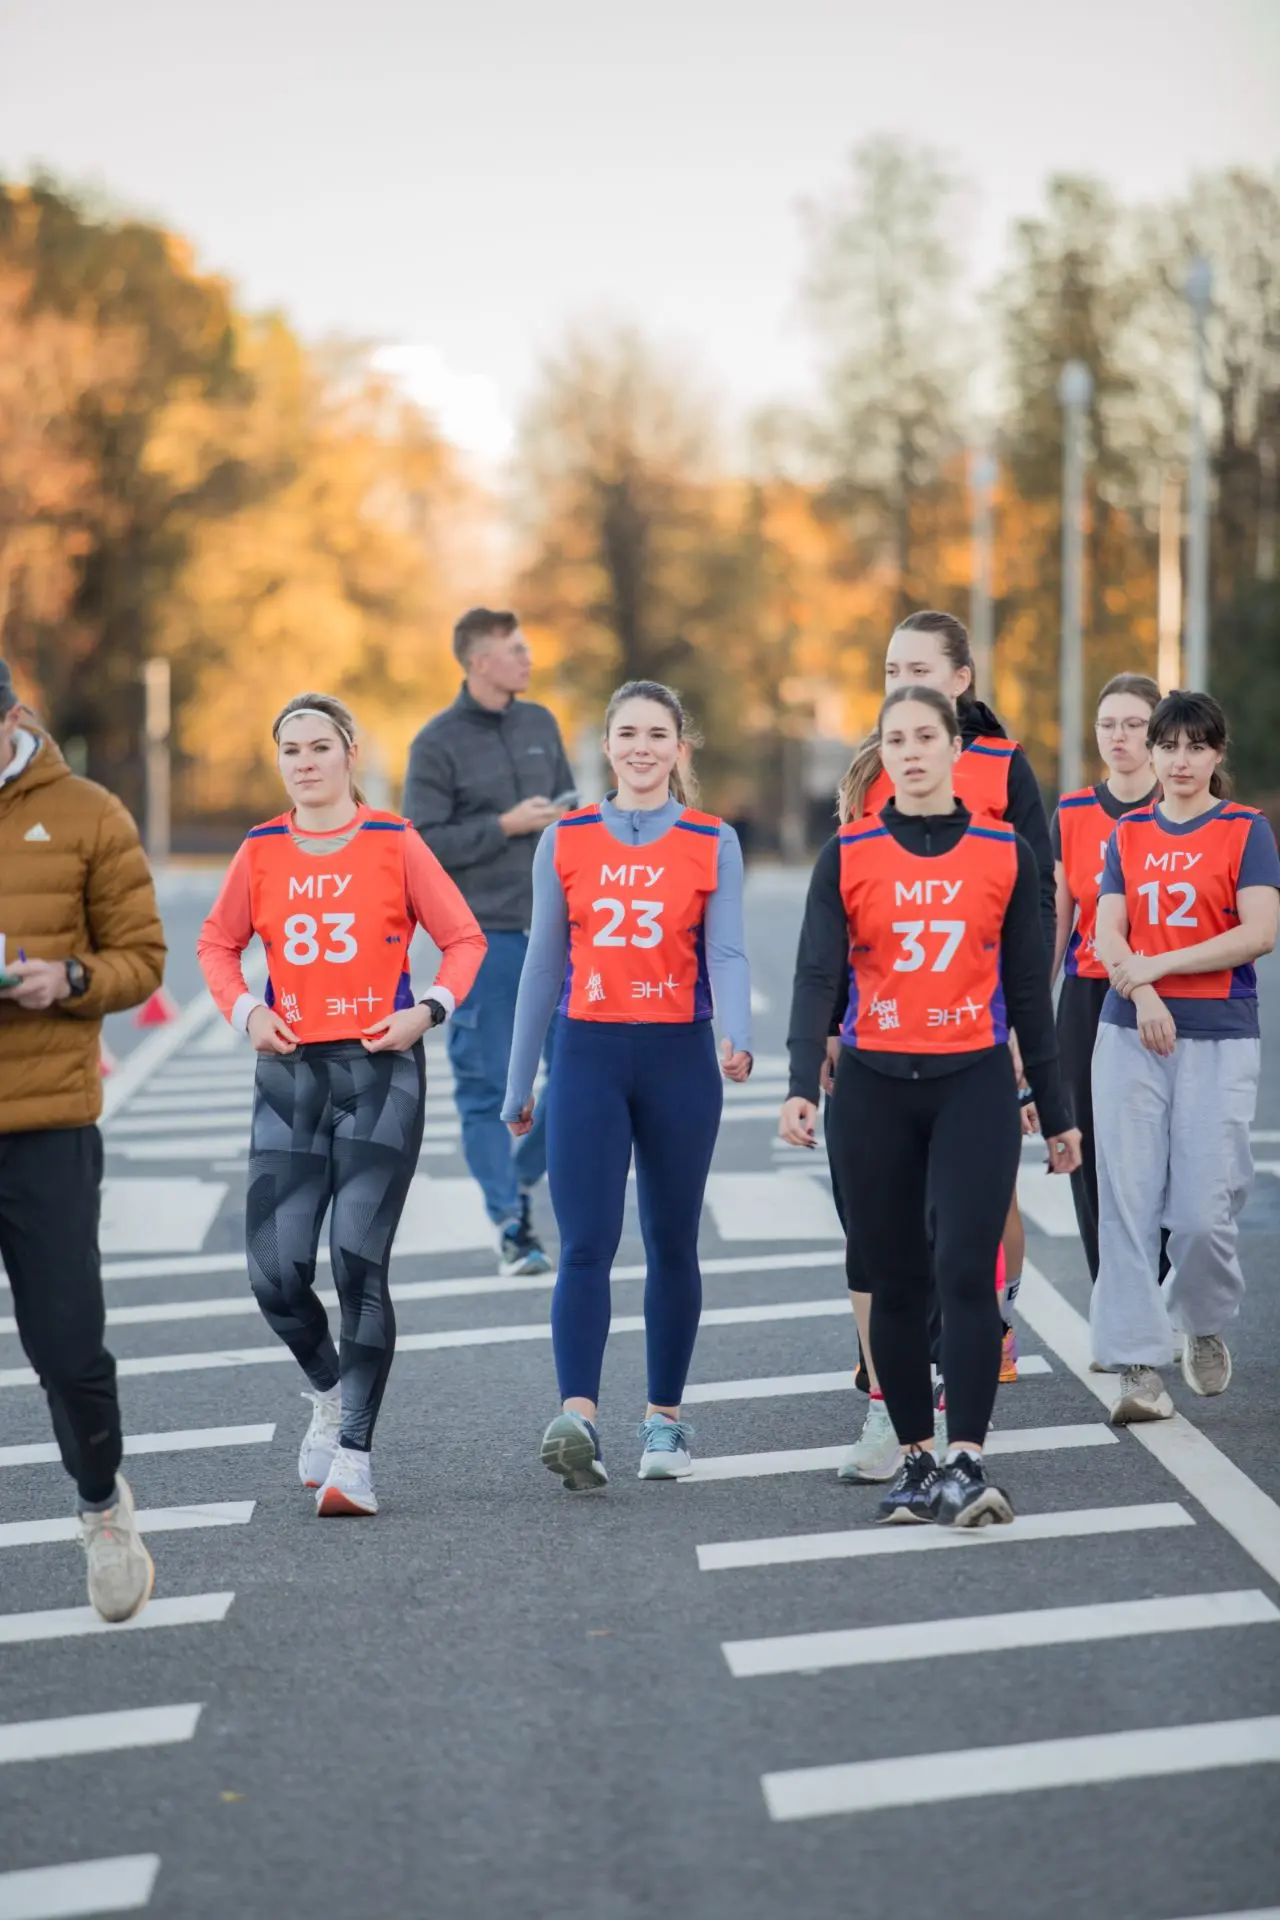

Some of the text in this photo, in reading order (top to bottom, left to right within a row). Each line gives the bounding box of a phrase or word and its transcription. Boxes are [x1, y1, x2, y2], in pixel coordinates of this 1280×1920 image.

[600, 864, 665, 887] МГУ
[1144, 852, 1203, 872] МГУ
[288, 874, 353, 900] МГУ
[895, 880, 963, 906] МГУ
[1137, 881, 1198, 927] 12
[284, 913, 358, 966] 83
[591, 898, 664, 948] 23
[892, 920, 966, 972] 37
